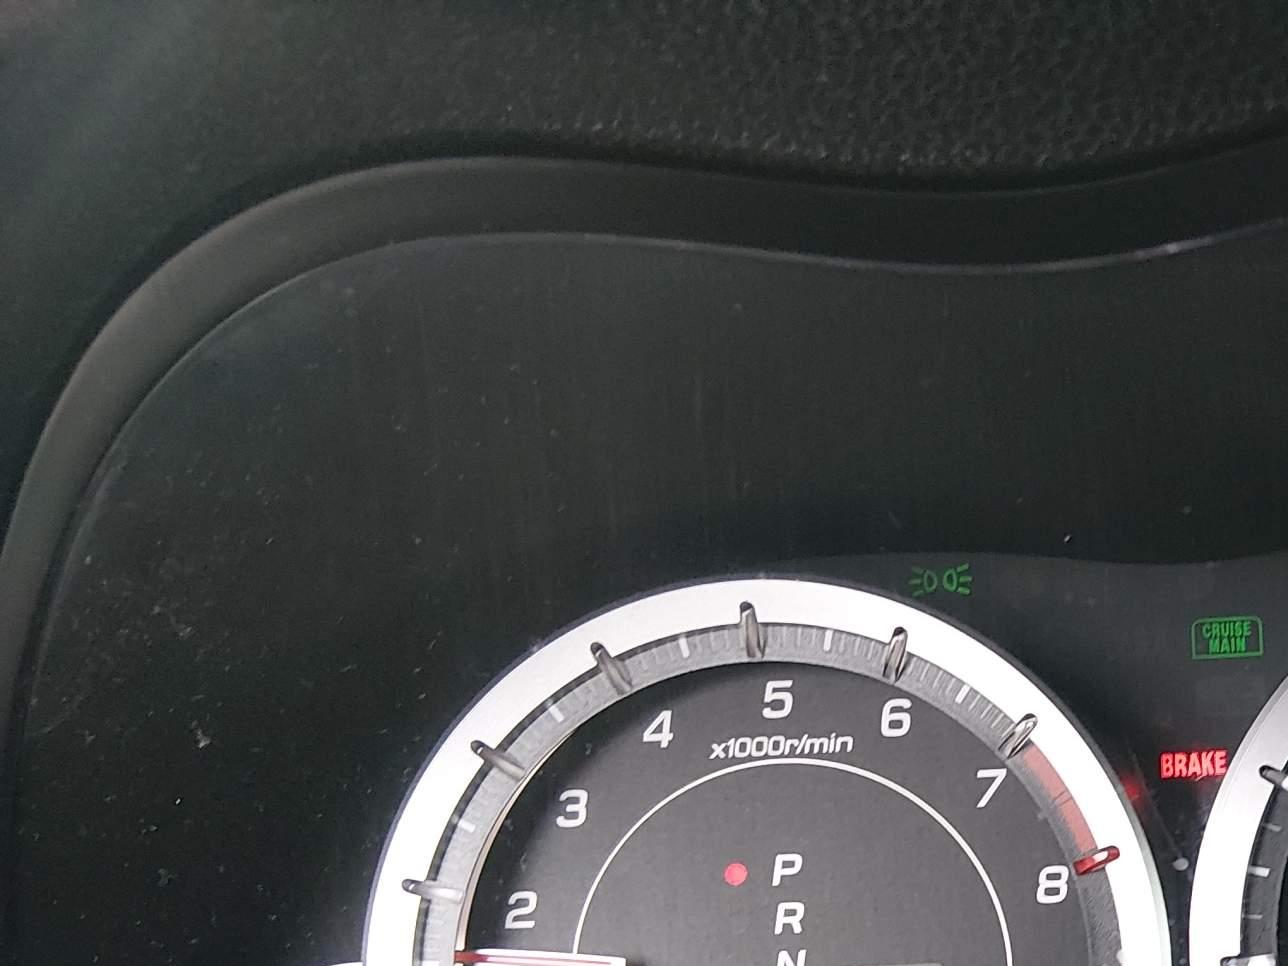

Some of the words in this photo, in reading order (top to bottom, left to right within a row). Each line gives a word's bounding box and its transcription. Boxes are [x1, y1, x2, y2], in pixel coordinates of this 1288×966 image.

[1199, 620, 1254, 638] CRUISE
[1206, 636, 1248, 655] MAIN
[762, 679, 794, 719] 5
[880, 698, 912, 738] 6
[642, 710, 674, 749] 4
[709, 733, 854, 760] x1000r/min
[1159, 750, 1228, 779] BRAKE
[976, 768, 1007, 808] 7
[555, 789, 589, 828] 3
[771, 853, 803, 887] P
[1036, 865, 1070, 904] 8
[504, 890, 538, 930] 2
[774, 901, 805, 935] R
